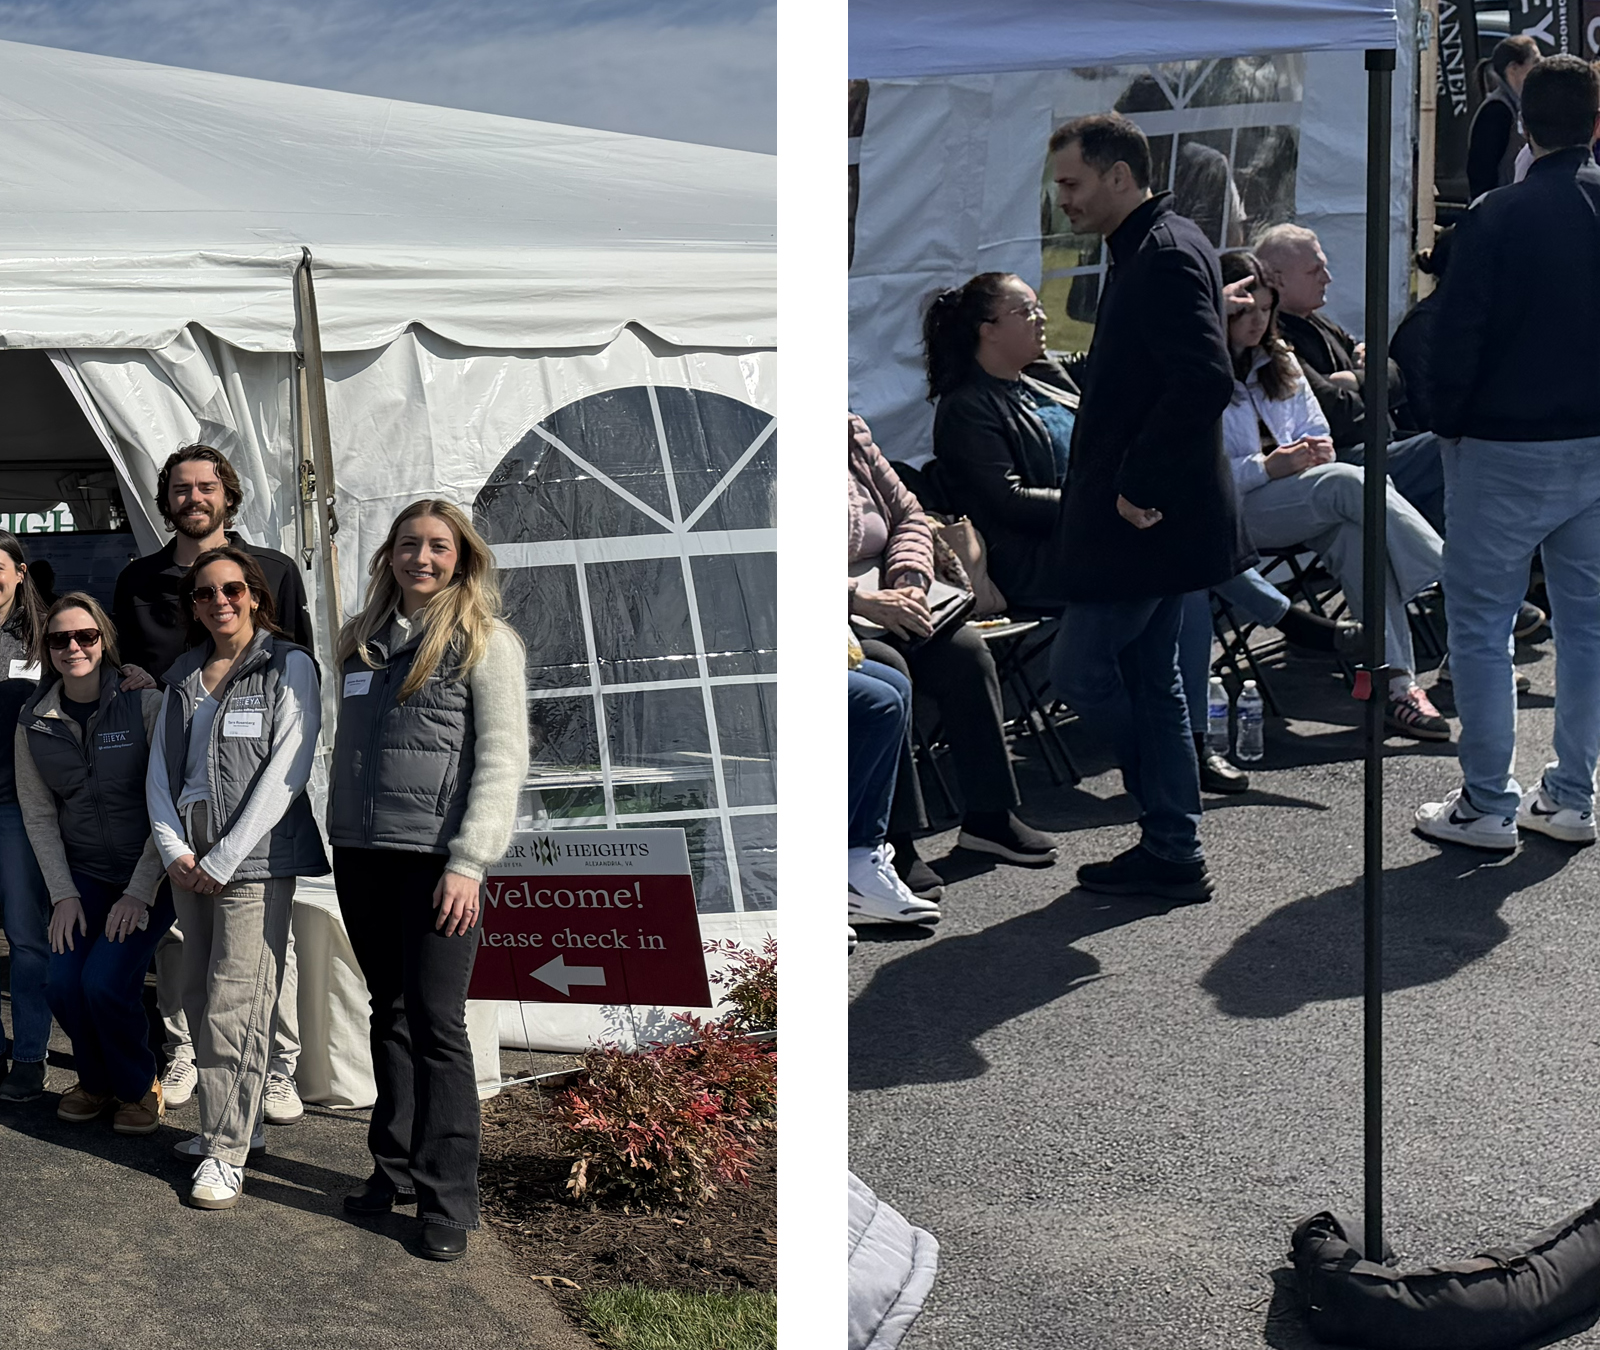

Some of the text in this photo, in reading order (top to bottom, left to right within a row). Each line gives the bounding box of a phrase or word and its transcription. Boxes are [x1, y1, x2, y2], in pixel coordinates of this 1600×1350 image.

[245, 697, 261, 706] EYA
[111, 734, 126, 742] EYA
[565, 843, 650, 857] HEIGHTS
[585, 860, 622, 868] ALEXANDRIA,
[480, 927, 667, 950] lease check in
